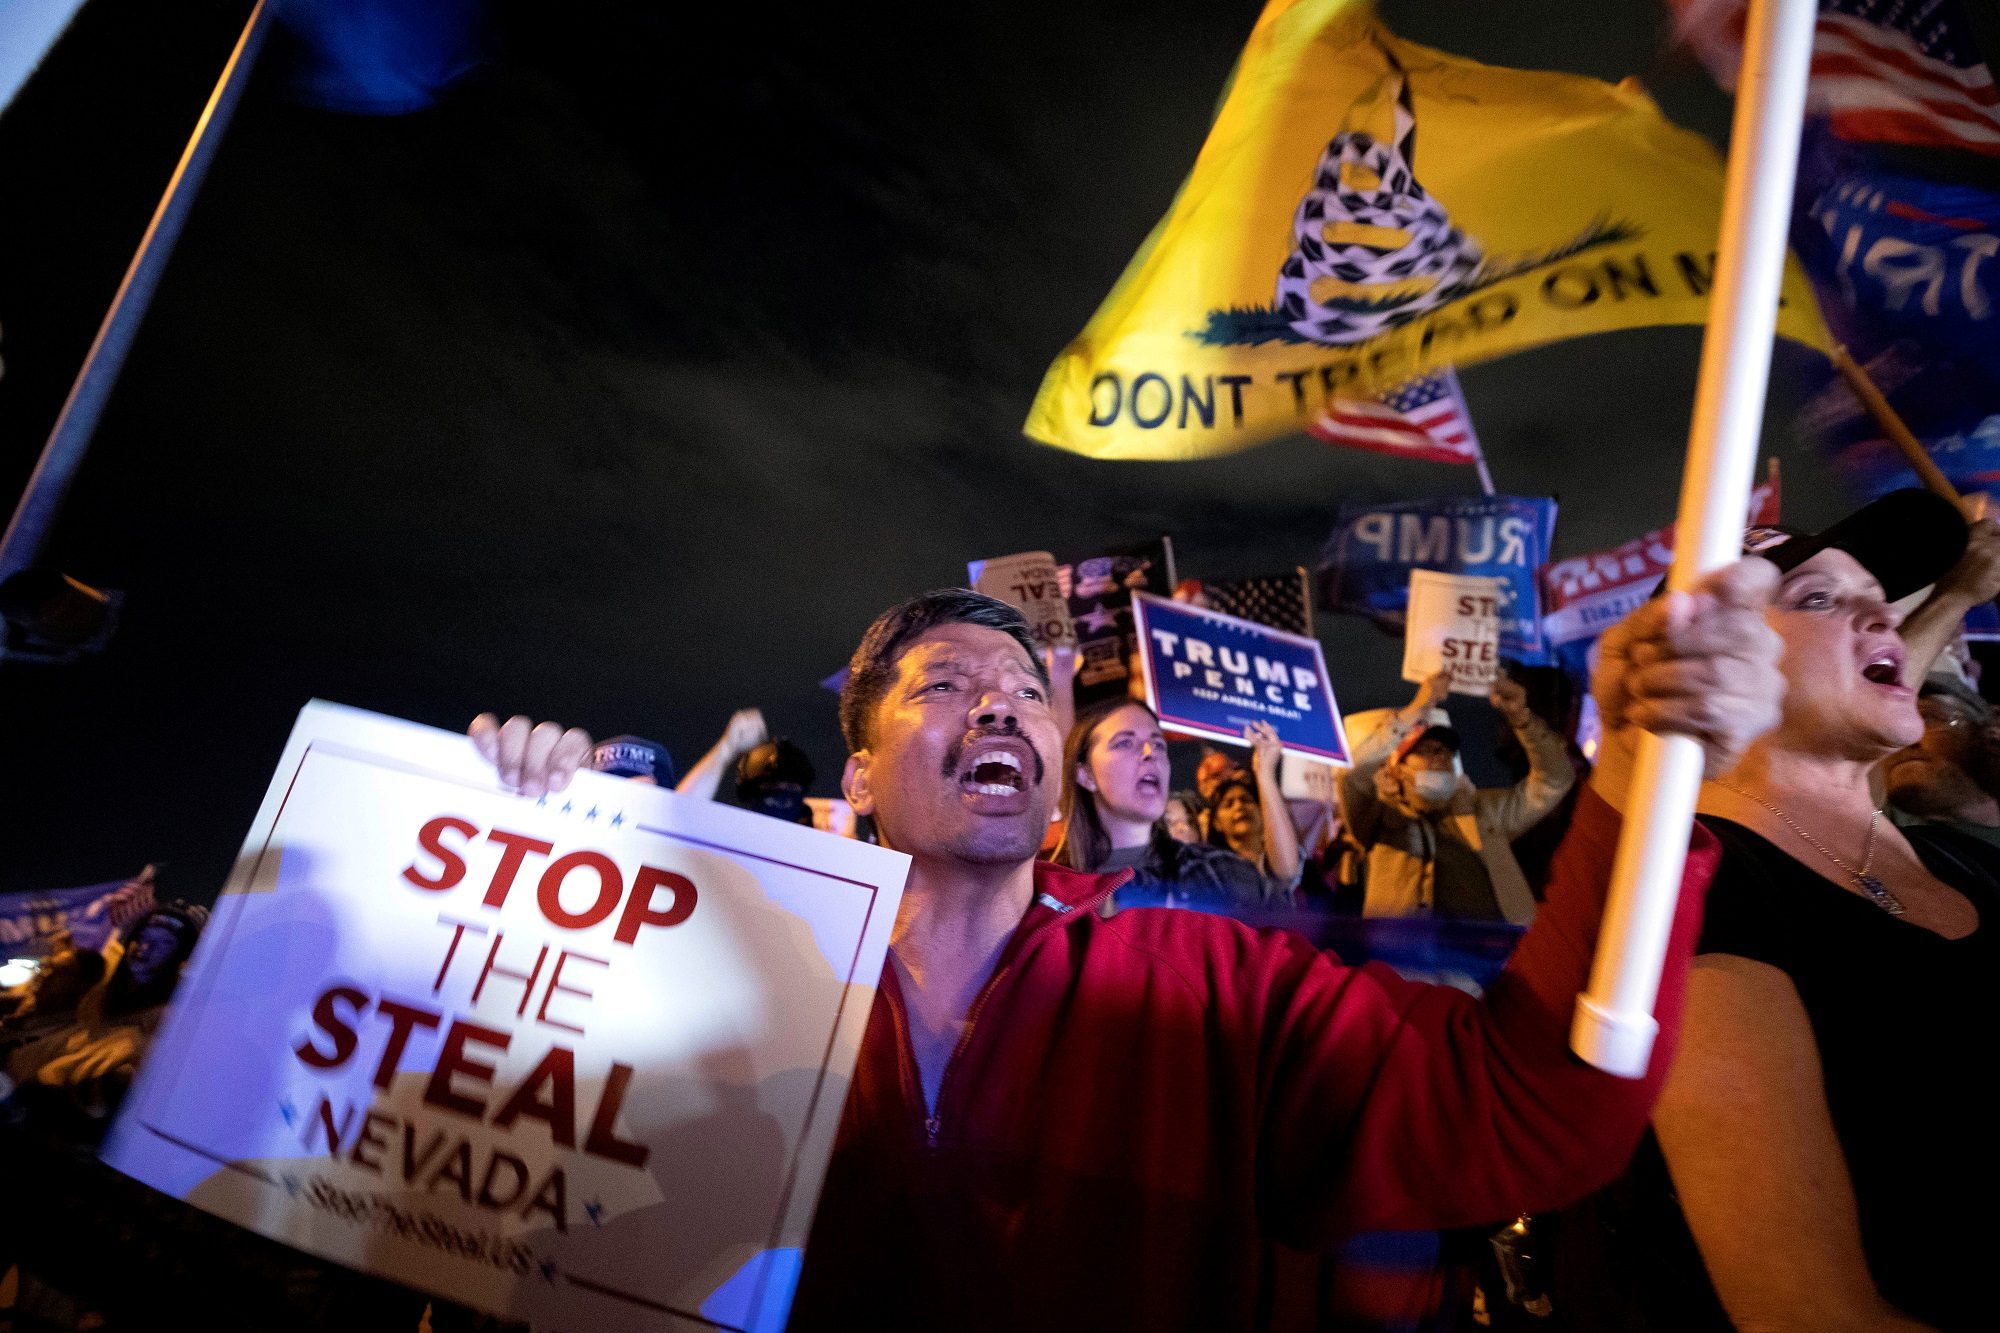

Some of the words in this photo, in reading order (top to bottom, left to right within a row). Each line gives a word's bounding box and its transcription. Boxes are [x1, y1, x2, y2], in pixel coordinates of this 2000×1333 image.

[1088, 371, 1252, 430] DONT
[1541, 252, 1660, 309] ON
[1151, 628, 1318, 692] TRUMP
[1173, 661, 1313, 711] PENCE
[1442, 638, 1495, 661] STE
[594, 746, 655, 763] TRUMP
[402, 816, 698, 947] STOP
[432, 912, 611, 1035] THE
[295, 982, 651, 1169] STEAL
[299, 1095, 569, 1236] NEVADA
